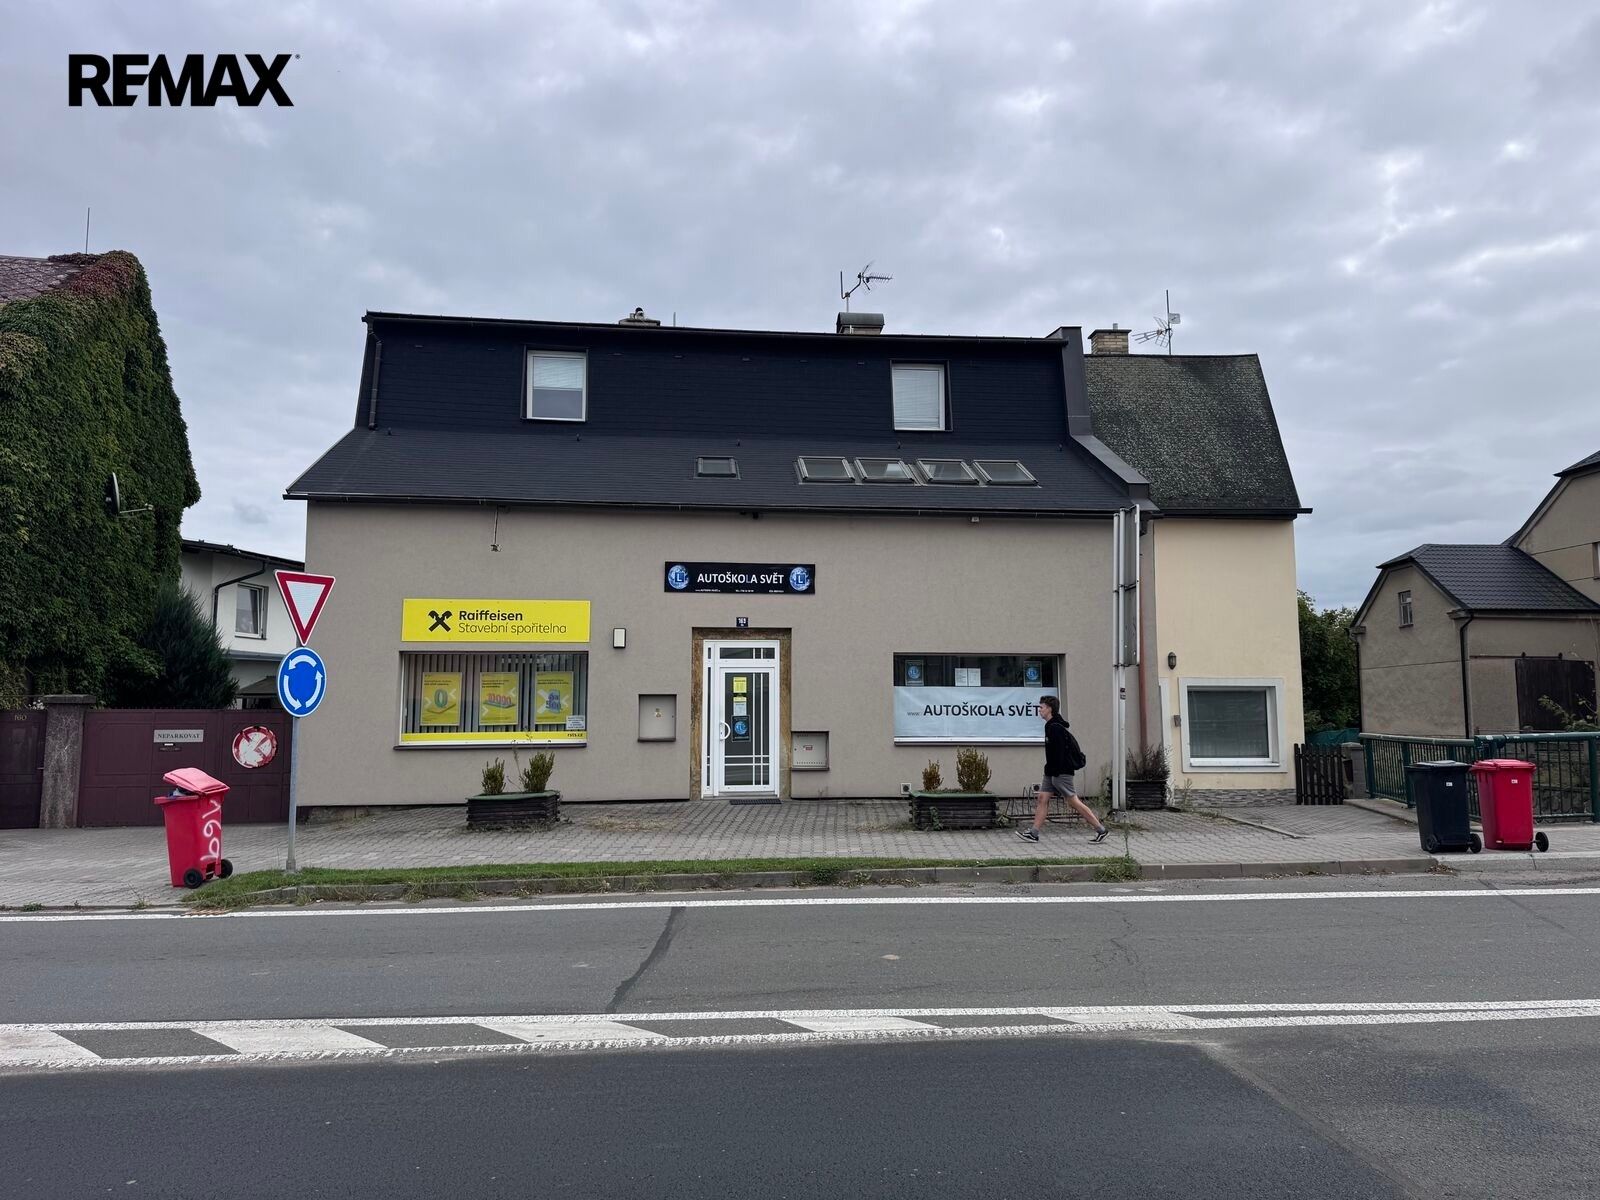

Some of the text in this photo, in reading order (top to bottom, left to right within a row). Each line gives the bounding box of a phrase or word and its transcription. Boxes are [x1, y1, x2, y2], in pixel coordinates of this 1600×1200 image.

[697, 572, 784, 584] AUTOŠKOLA SVĚT
[459, 610, 523, 621] Raiffeisen
[458, 622, 567, 635] Stavební spořitelna
[923, 702, 1004, 717] AUTOŠKOLA
[1008, 702, 1040, 717] SVĚT
